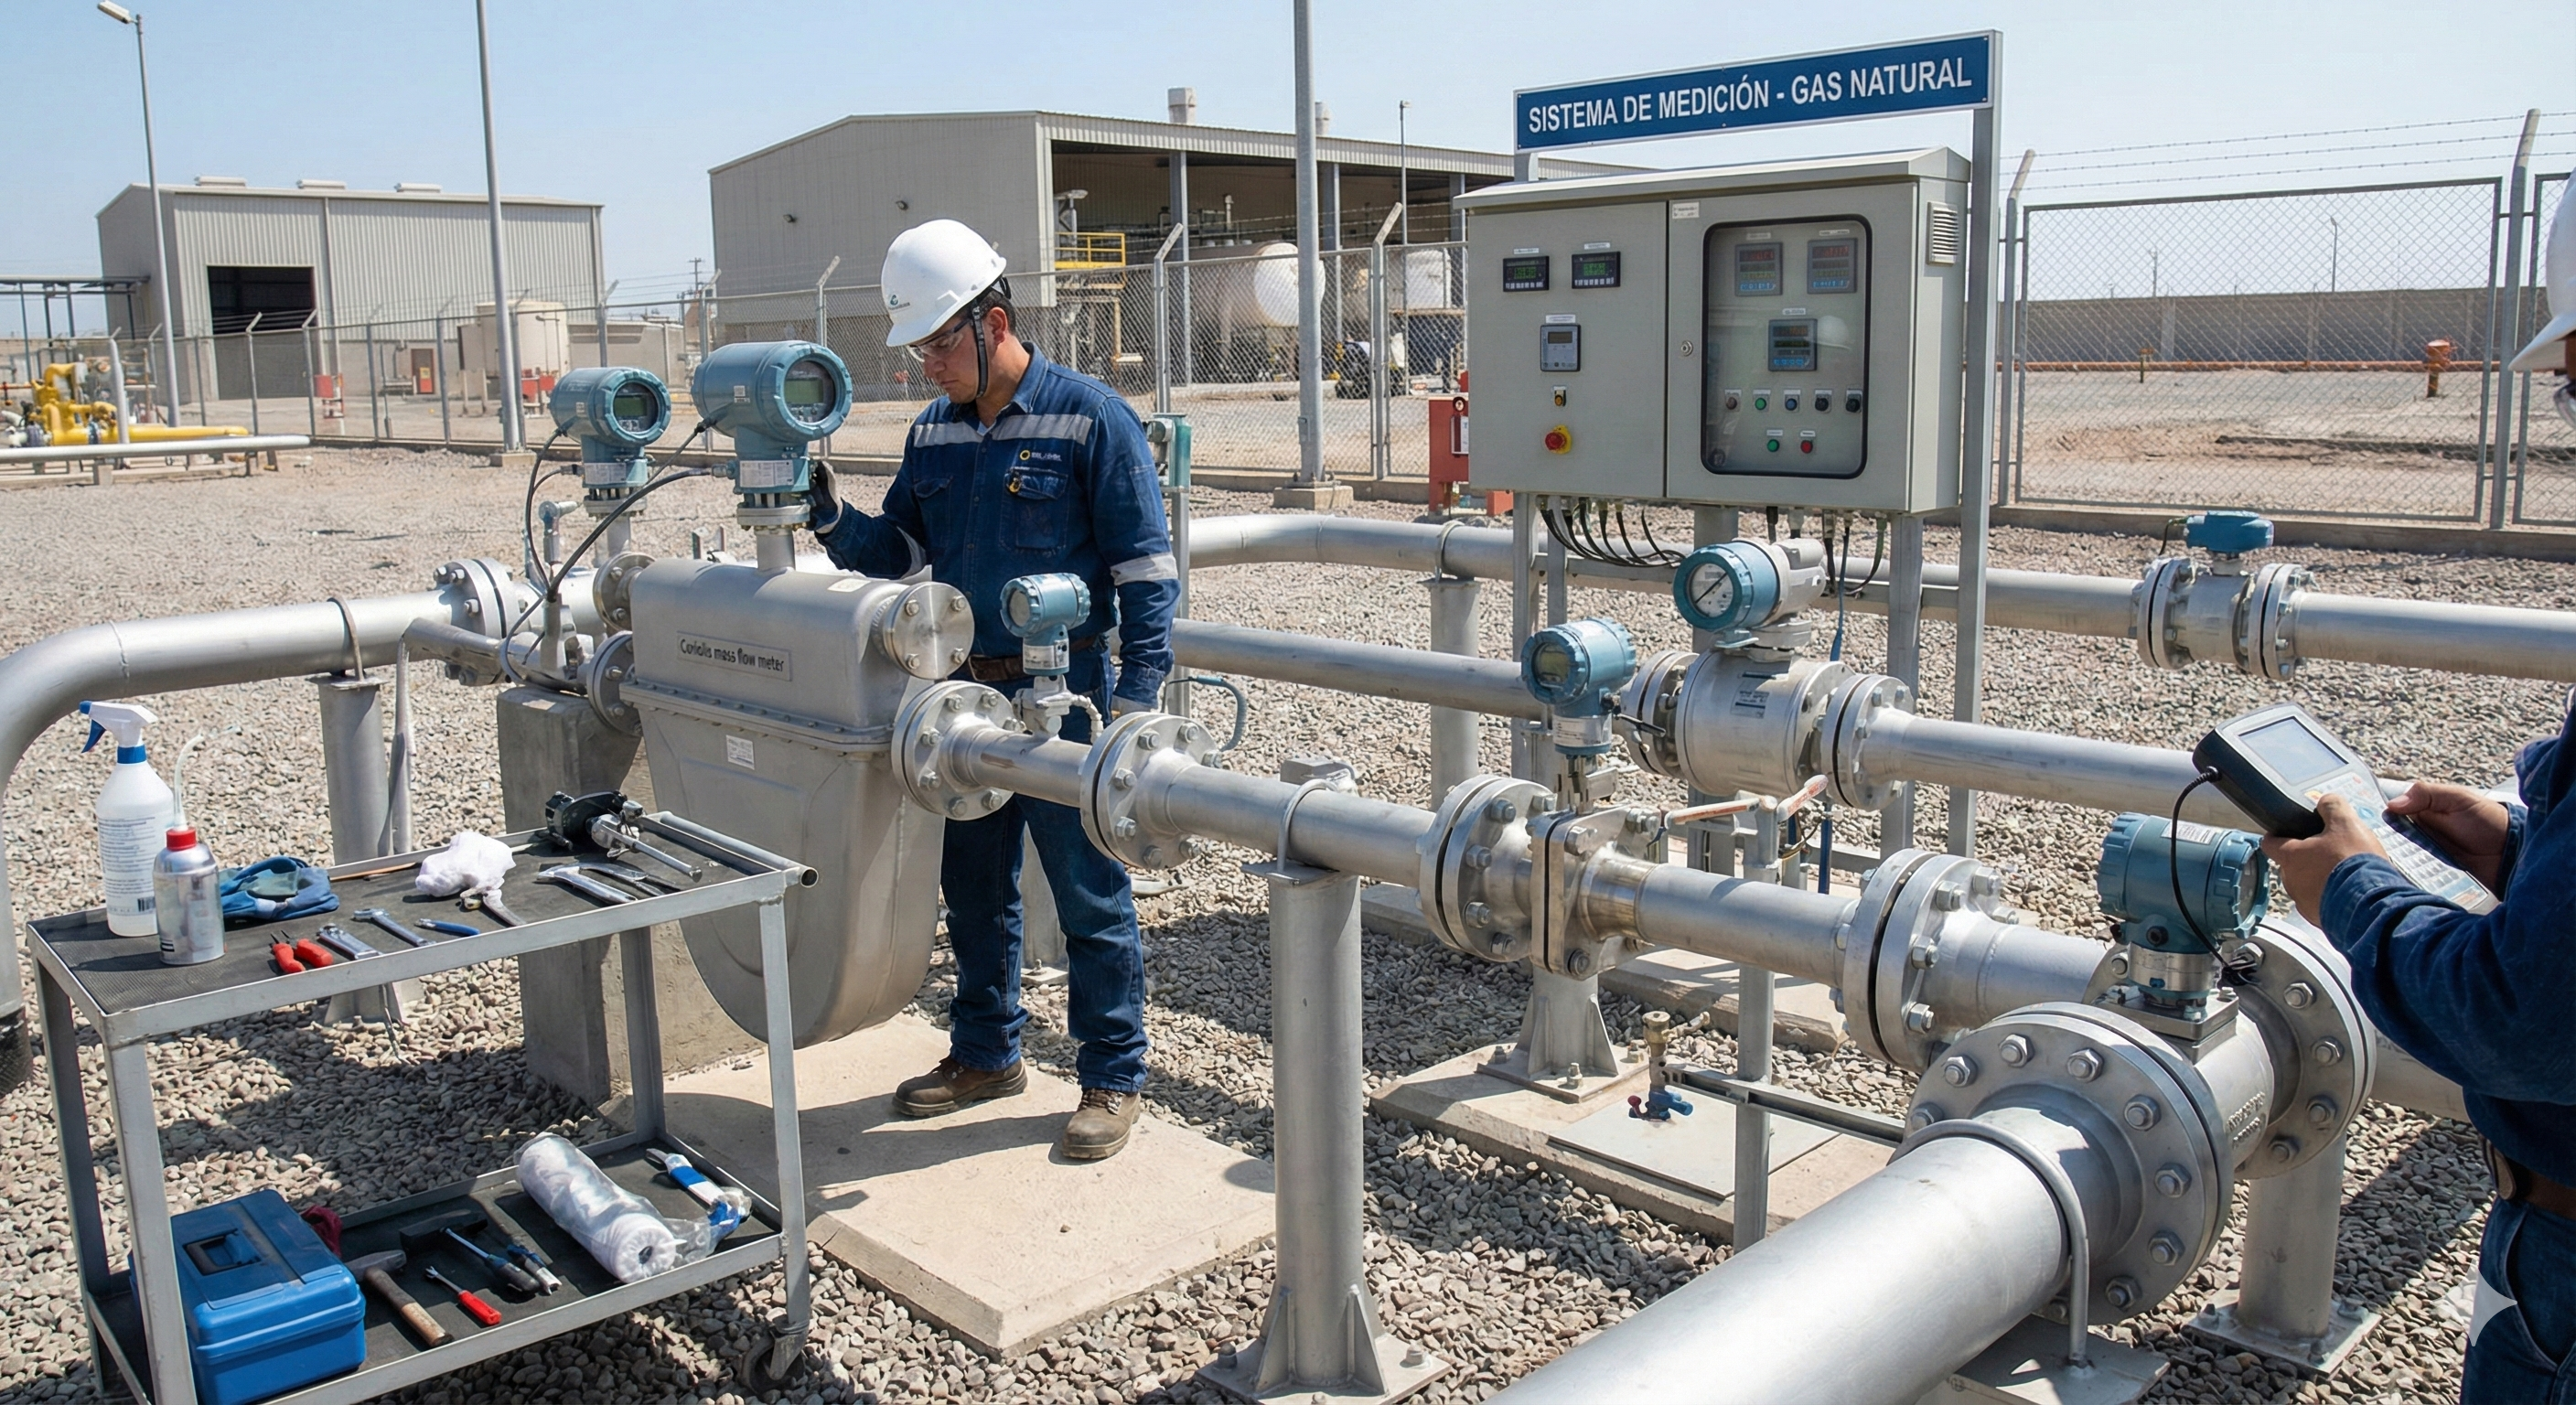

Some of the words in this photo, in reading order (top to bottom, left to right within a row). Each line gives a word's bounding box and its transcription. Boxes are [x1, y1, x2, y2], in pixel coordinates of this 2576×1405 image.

[1529, 98, 1618, 134] SISTEMA
[1623, 93, 1652, 123] DE
[1658, 74, 1769, 119] MEDICIÓN
[1776, 91, 1785, 100] -
[1791, 70, 1842, 105] GAS
[1850, 57, 1972, 99] NATURAL
